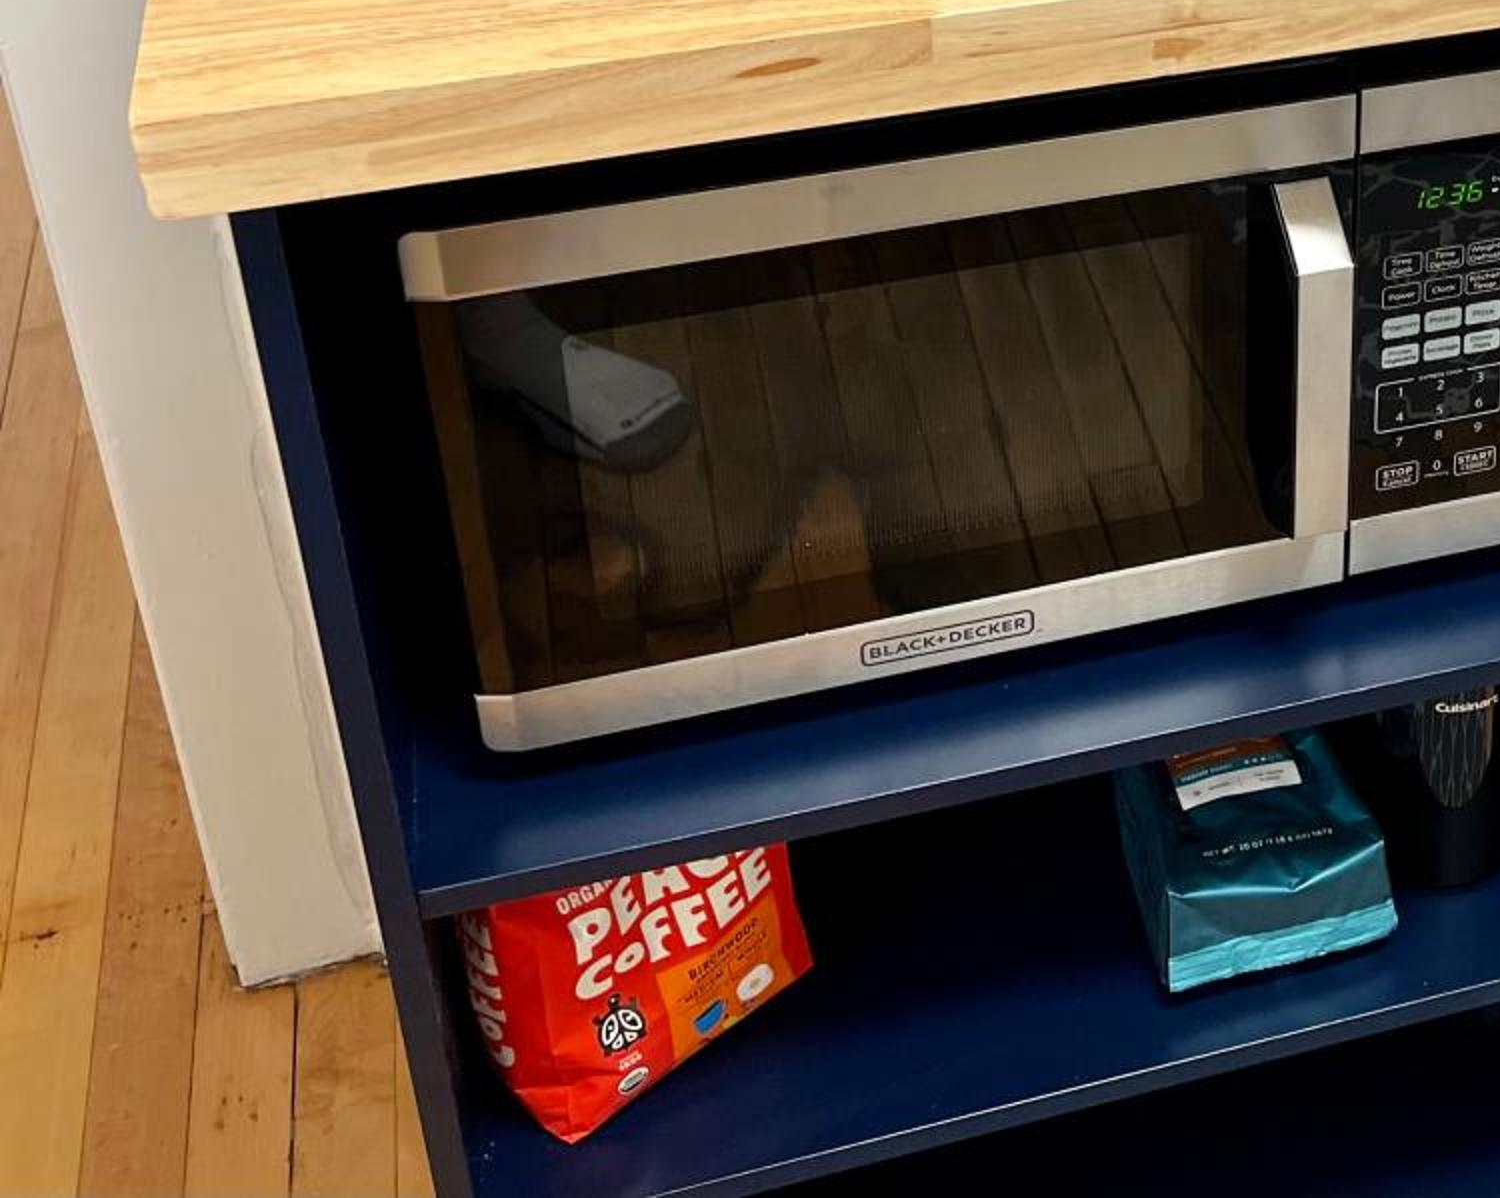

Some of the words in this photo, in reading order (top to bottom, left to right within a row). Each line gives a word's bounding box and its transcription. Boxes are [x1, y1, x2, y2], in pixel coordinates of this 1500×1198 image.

[1436, 380, 1445, 391] 2
[1476, 371, 1484, 383] 3
[1395, 412, 1403, 422] 4
[1436, 404, 1443, 415] 5
[1474, 397, 1483, 408] 6
[1395, 436, 1404, 447] 7
[1434, 429, 1443, 440] 8
[1473, 421, 1482, 433] 9
[1432, 460, 1441, 471] 0
[1458, 450, 1493, 464] START
[1383, 465, 1413, 478] STOP
[869, 617, 1026, 659] BLACK+DECKER
[1435, 694, 1498, 713] Cuisinart
[575, 847, 772, 1000] COFFEE
